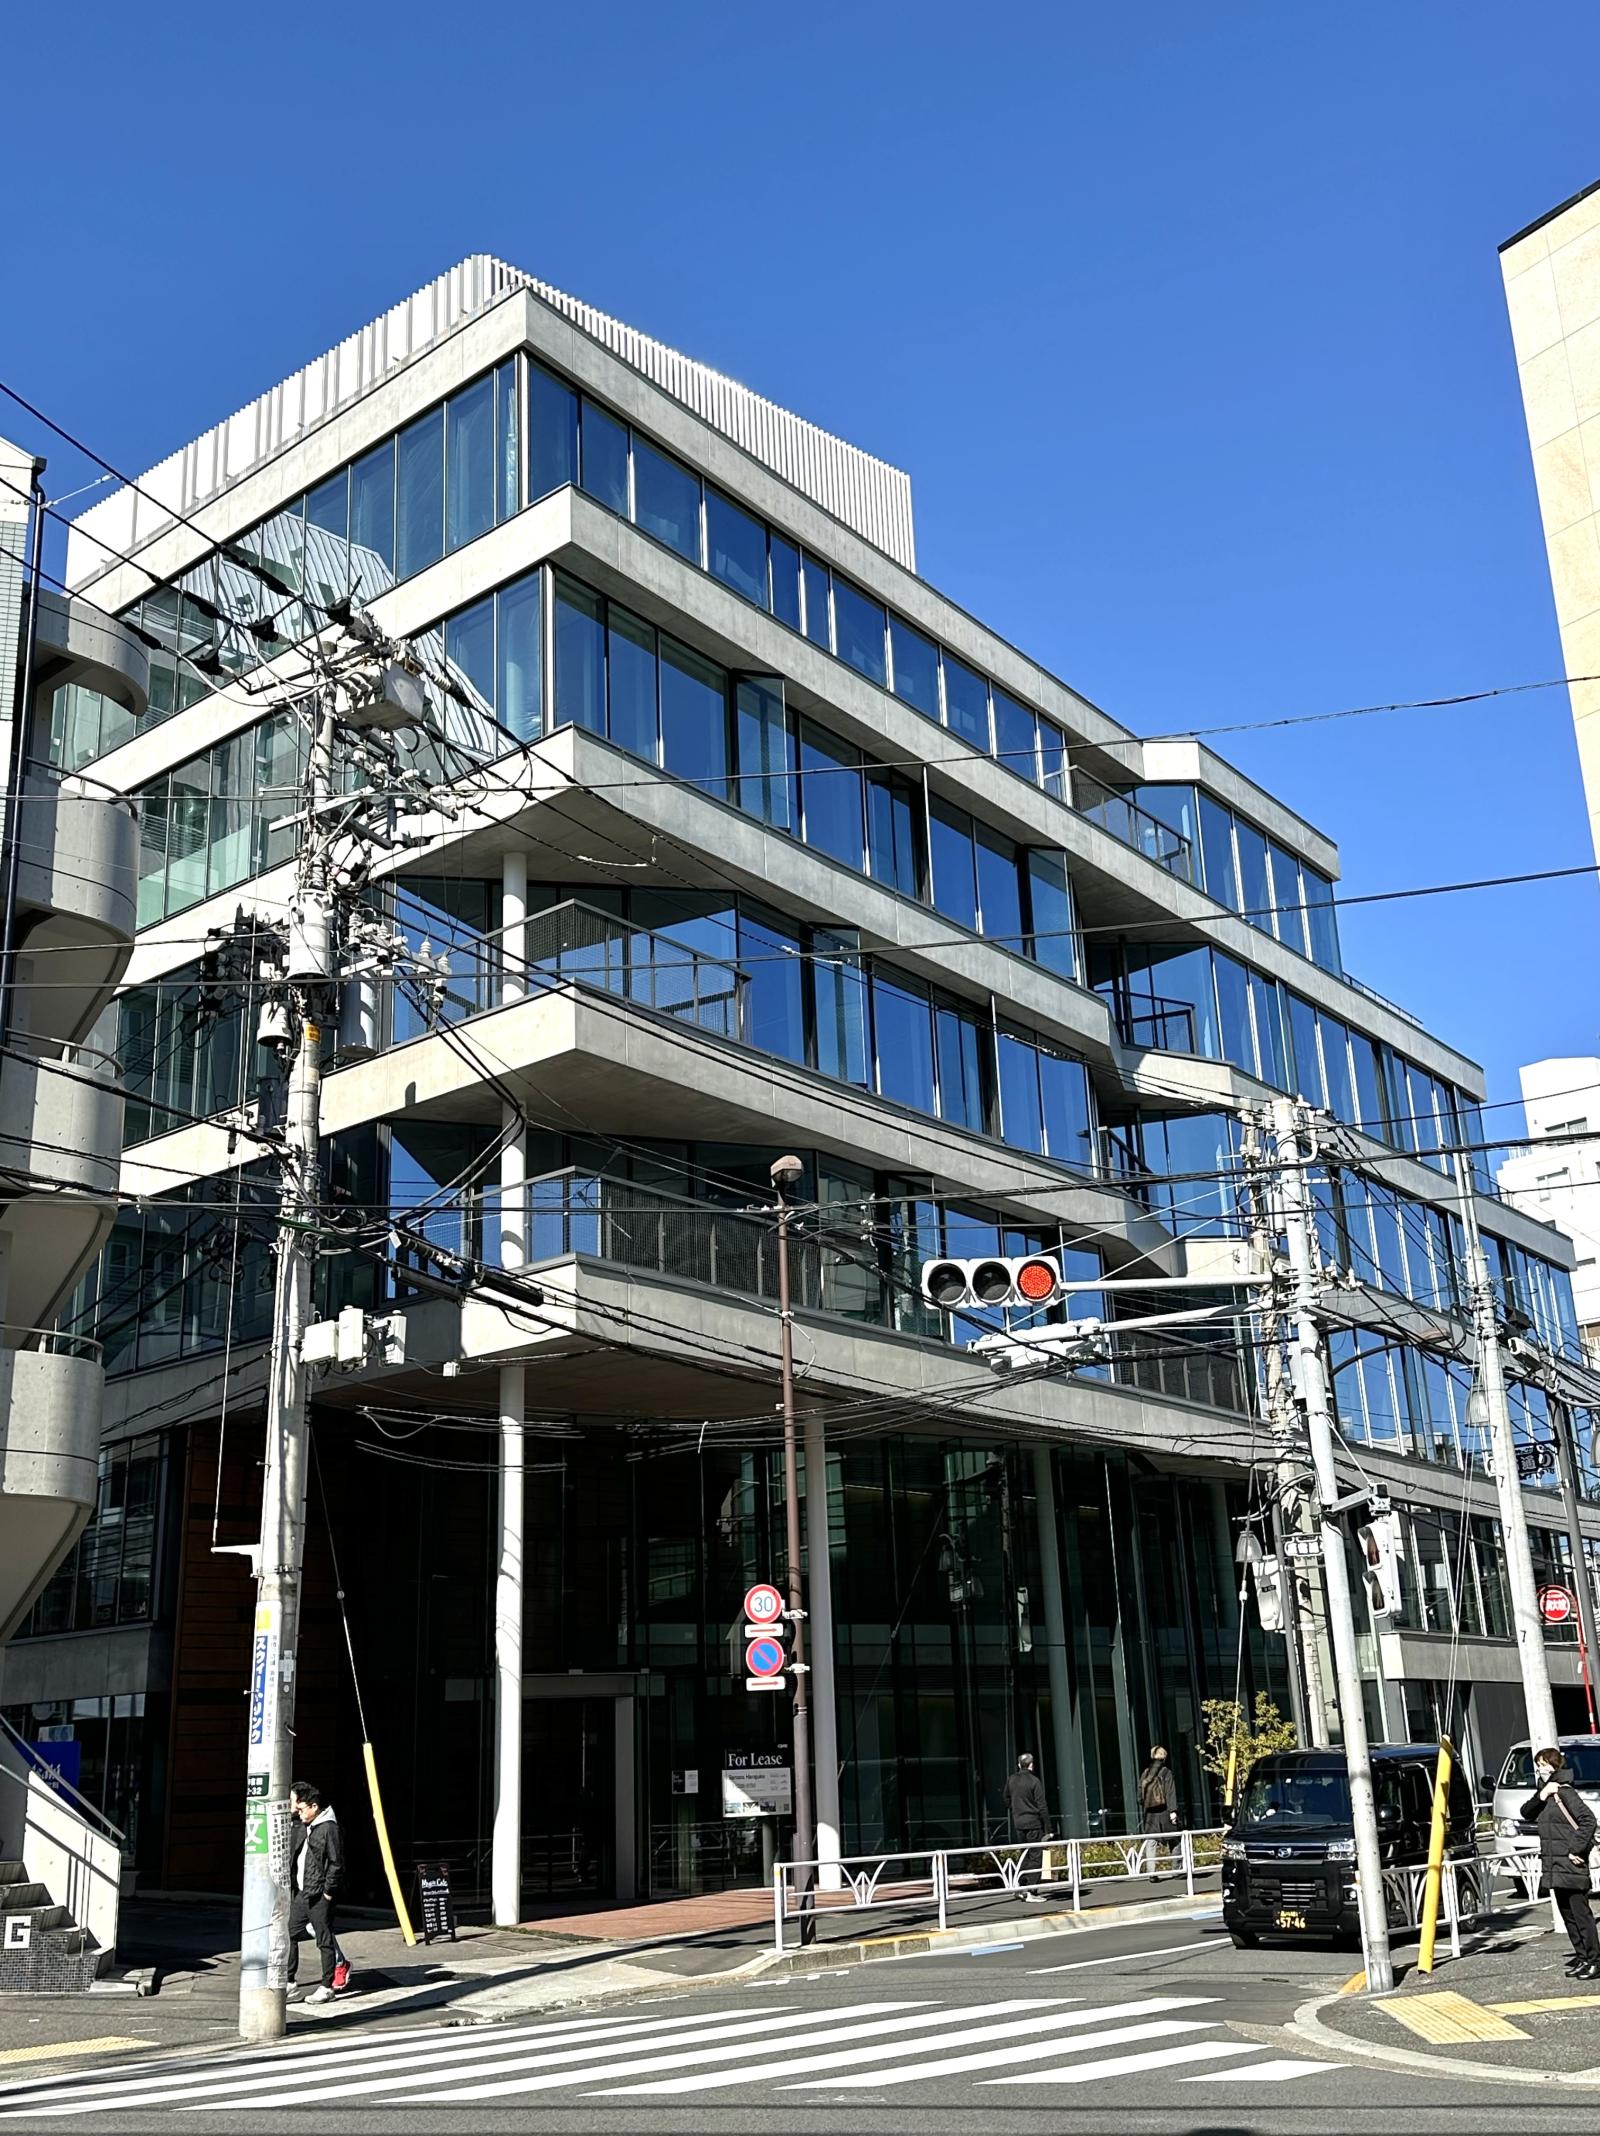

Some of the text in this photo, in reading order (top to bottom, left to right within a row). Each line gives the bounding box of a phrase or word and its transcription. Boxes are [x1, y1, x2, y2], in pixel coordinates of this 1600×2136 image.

[754, 1596, 773, 1613] 30
[728, 1752, 783, 1767] For Lease
[4, 1915, 32, 1950] G
